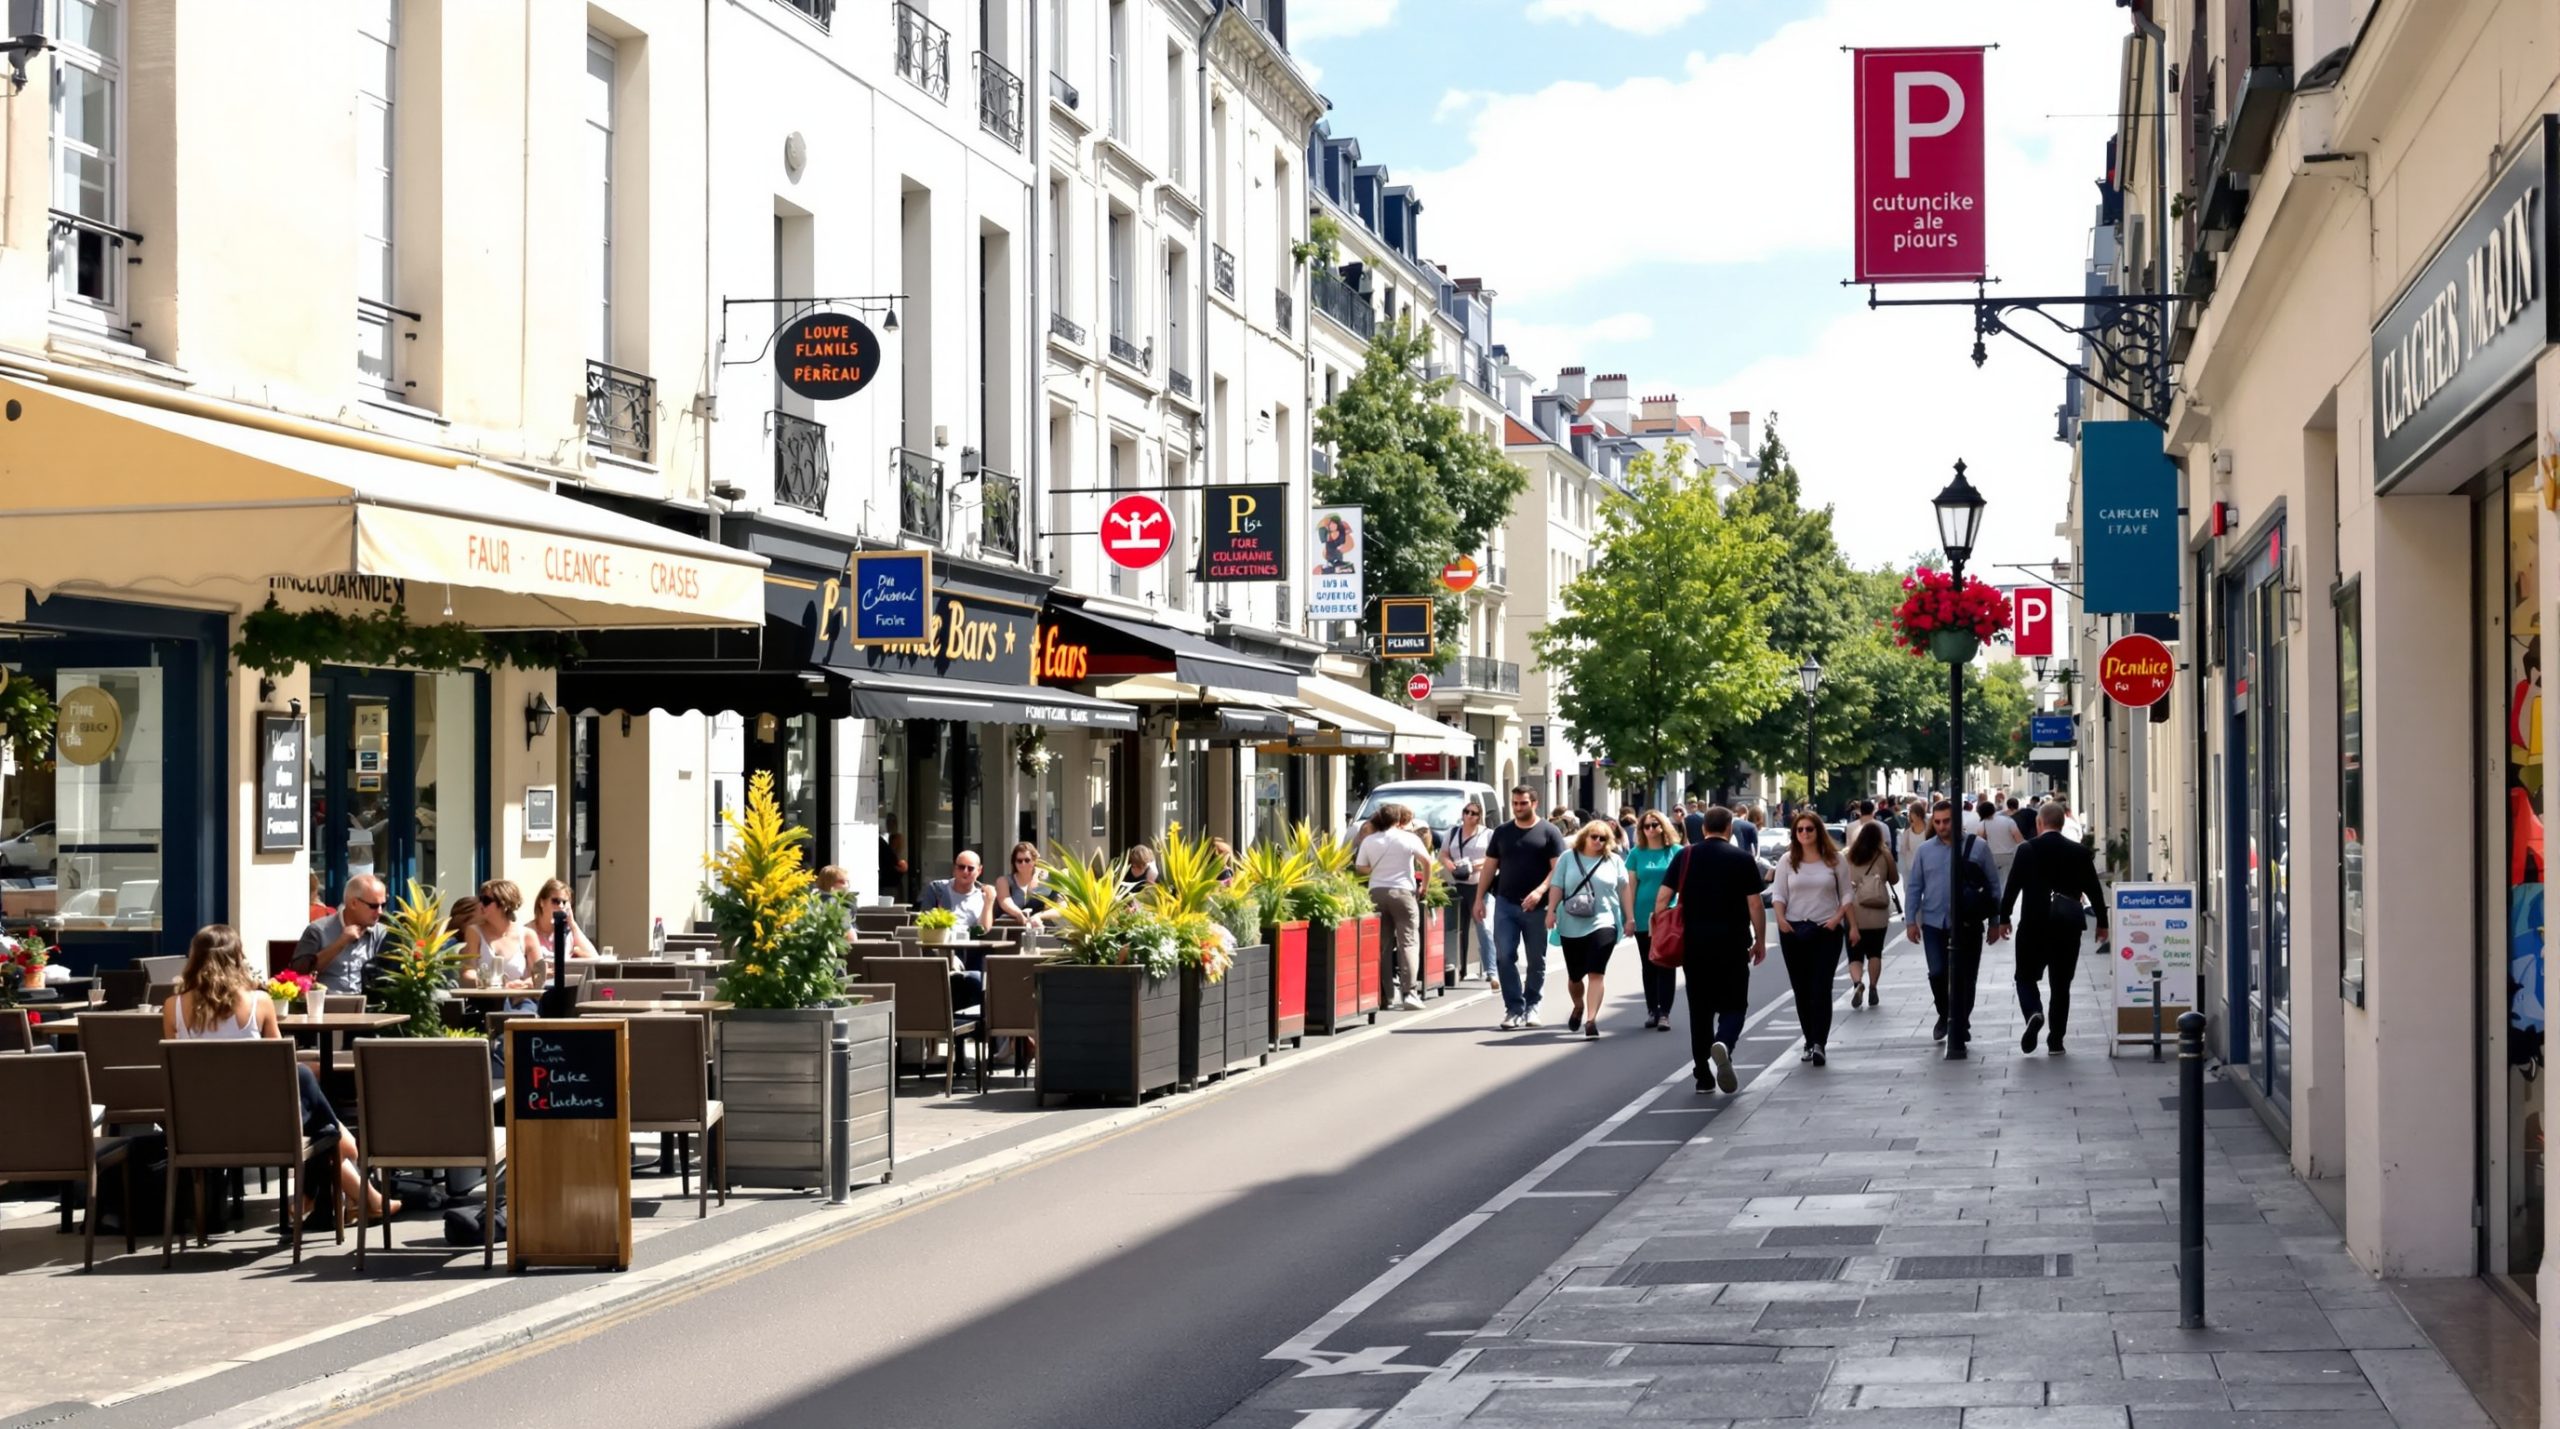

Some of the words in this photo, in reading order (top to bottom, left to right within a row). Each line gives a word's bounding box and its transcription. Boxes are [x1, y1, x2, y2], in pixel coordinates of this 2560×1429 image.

[1894, 71, 1965, 178] P
[1872, 192, 1974, 211] cutuncike
[1913, 212, 1943, 229] ale
[795, 342, 859, 357] FLANILS
[804, 325, 849, 340] LOUVE
[1228, 494, 1257, 533] P
[468, 535, 510, 575] FAUR
[545, 546, 611, 588] CLEANCE
[651, 561, 699, 600] CRASES
[945, 600, 997, 663] Bars
[2021, 597, 2047, 636] P
